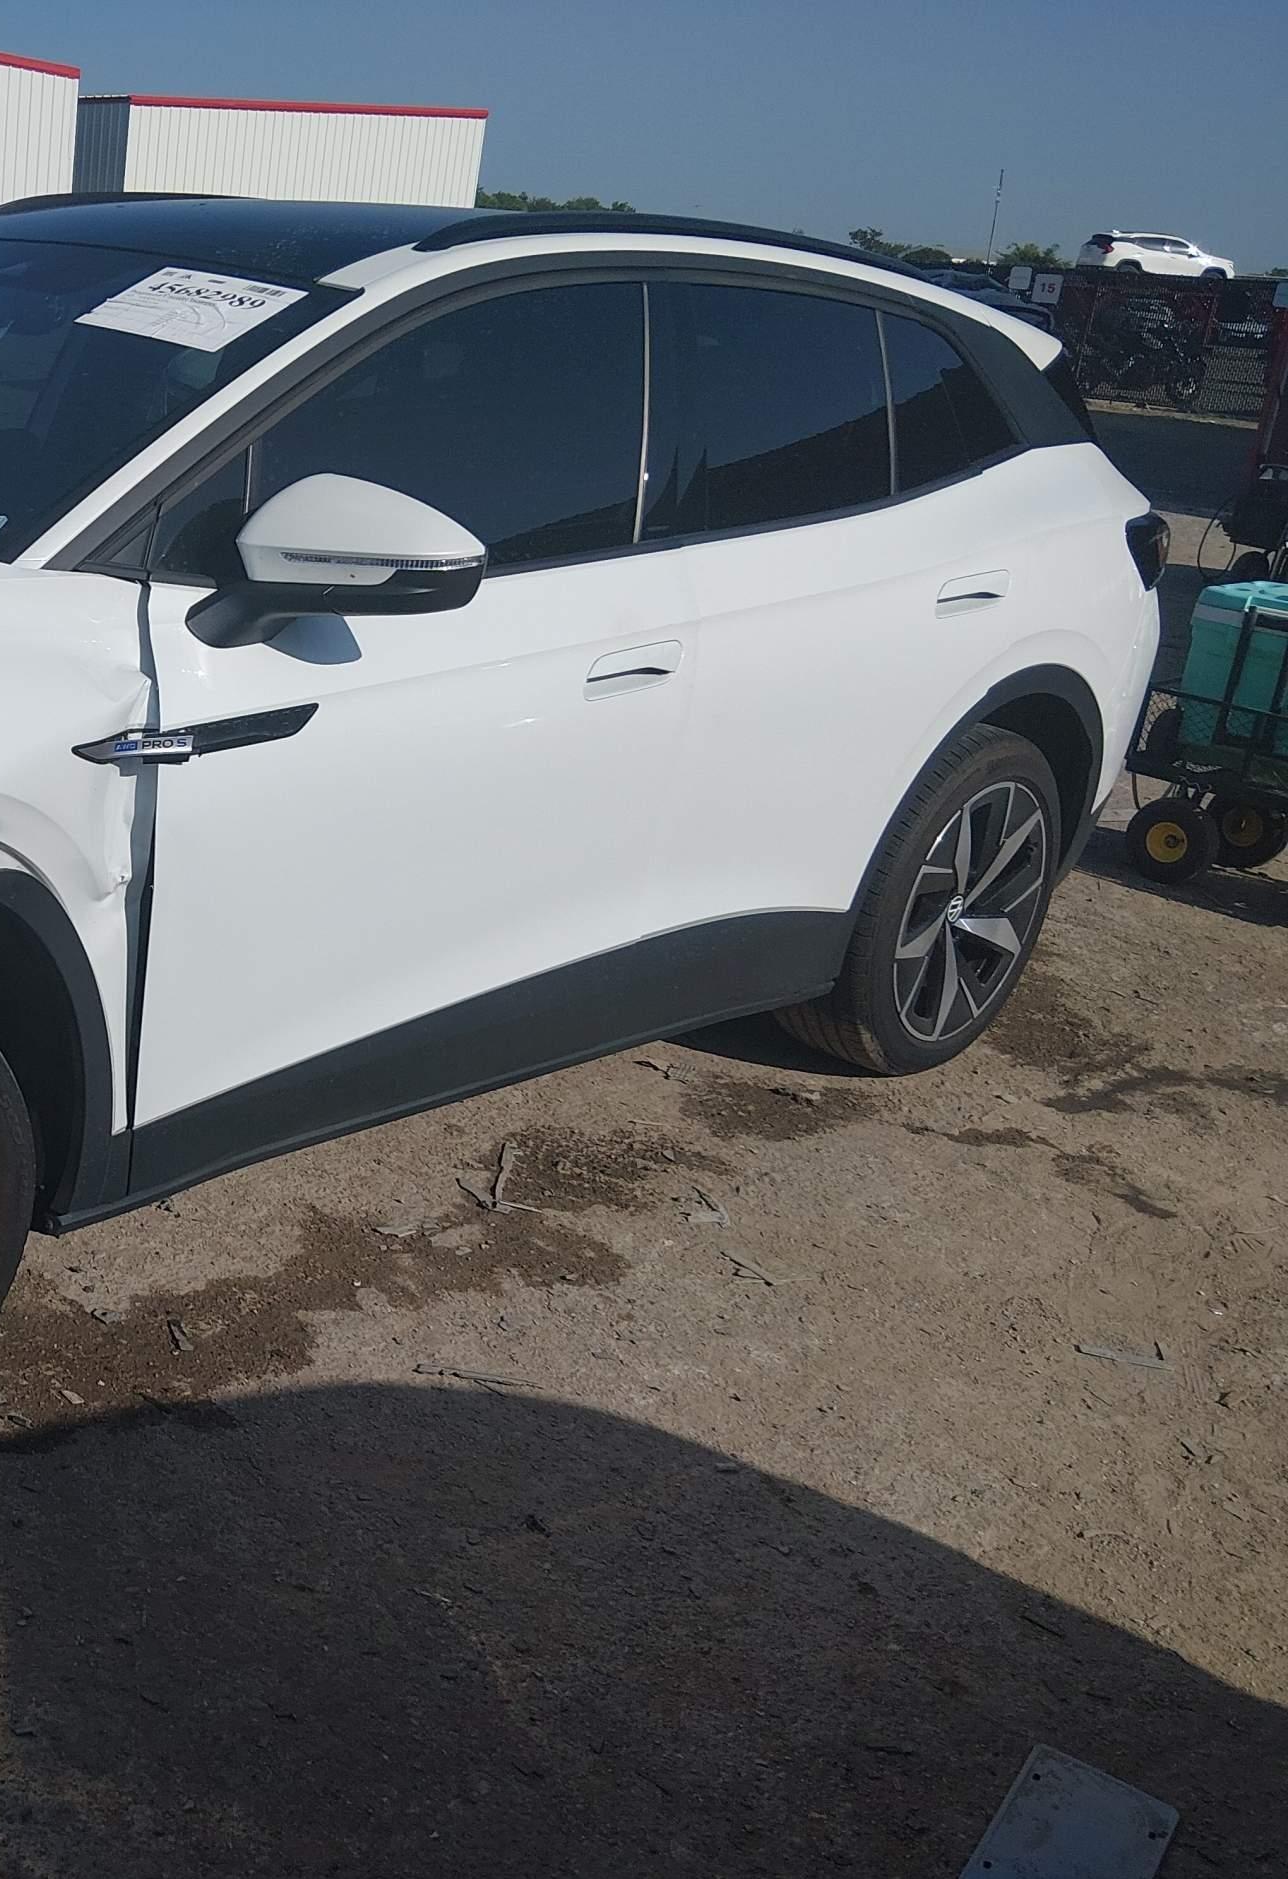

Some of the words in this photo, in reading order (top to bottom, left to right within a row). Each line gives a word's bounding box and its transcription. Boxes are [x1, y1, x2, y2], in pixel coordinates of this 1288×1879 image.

[1040, 282, 1056, 293] 15
[148, 281, 266, 310] 45682989
[142, 739, 173, 749] PRO
[176, 738, 187, 748] S
